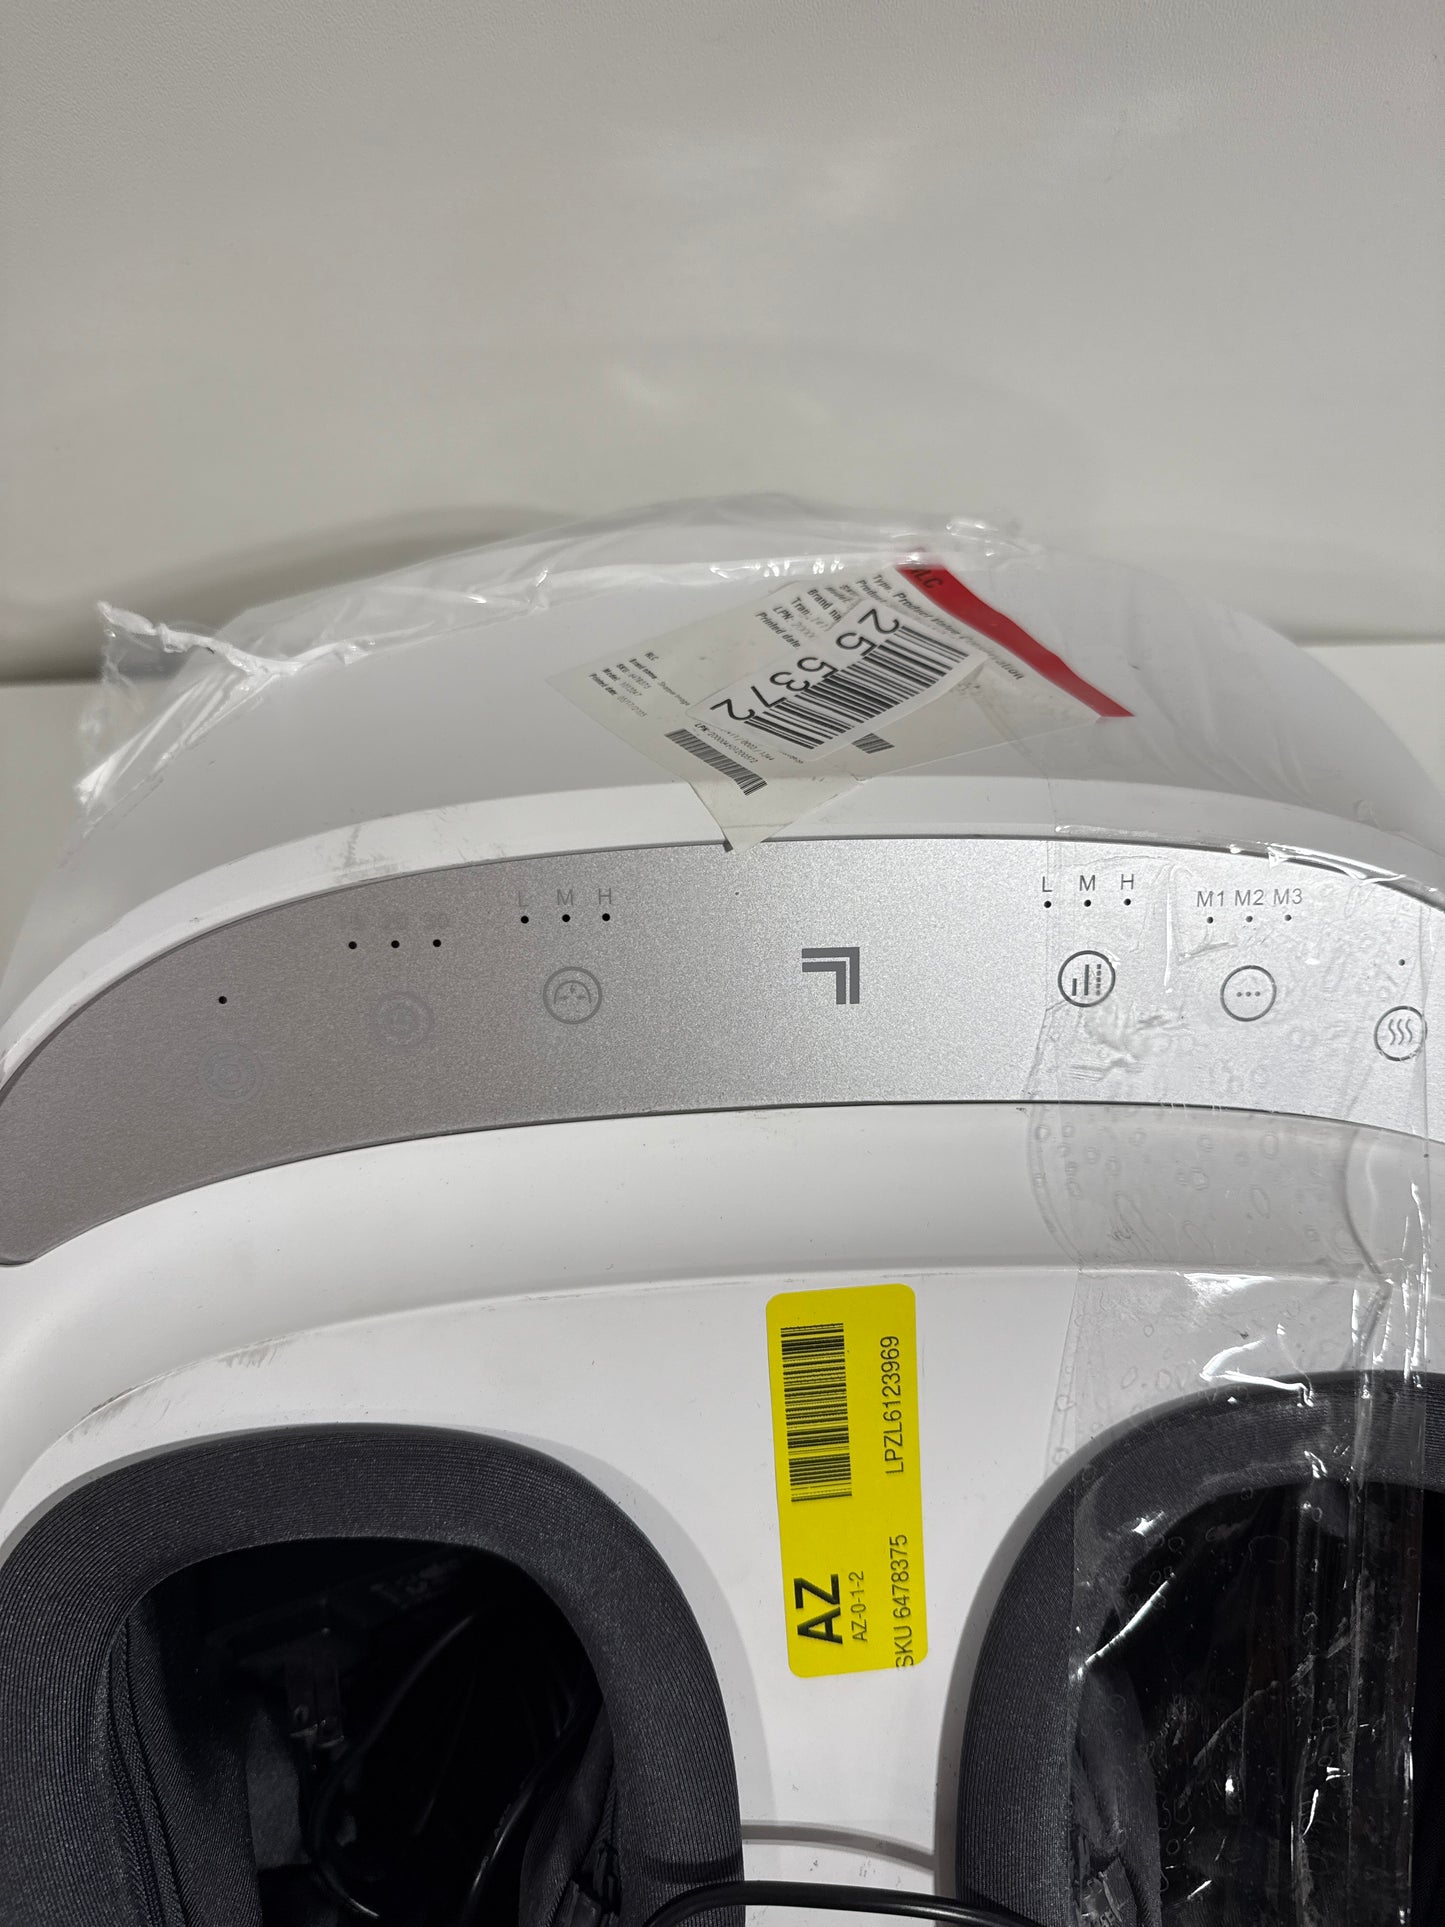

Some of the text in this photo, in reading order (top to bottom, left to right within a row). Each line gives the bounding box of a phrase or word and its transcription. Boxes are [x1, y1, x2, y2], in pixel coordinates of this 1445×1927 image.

[807, 589, 833, 610] Brand
[755, 612, 787, 635] Printed
[1042, 873, 1134, 892] L M H
[518, 887, 611, 907] L M H
[1196, 887, 1303, 907] M1 M2 M3
[880, 1335, 904, 1474] LPZL6123969
[793, 1573, 844, 1645] AZ
[848, 1570, 868, 1643] AZ-0-1-2
[889, 1534, 914, 1668] SKU 6478375
